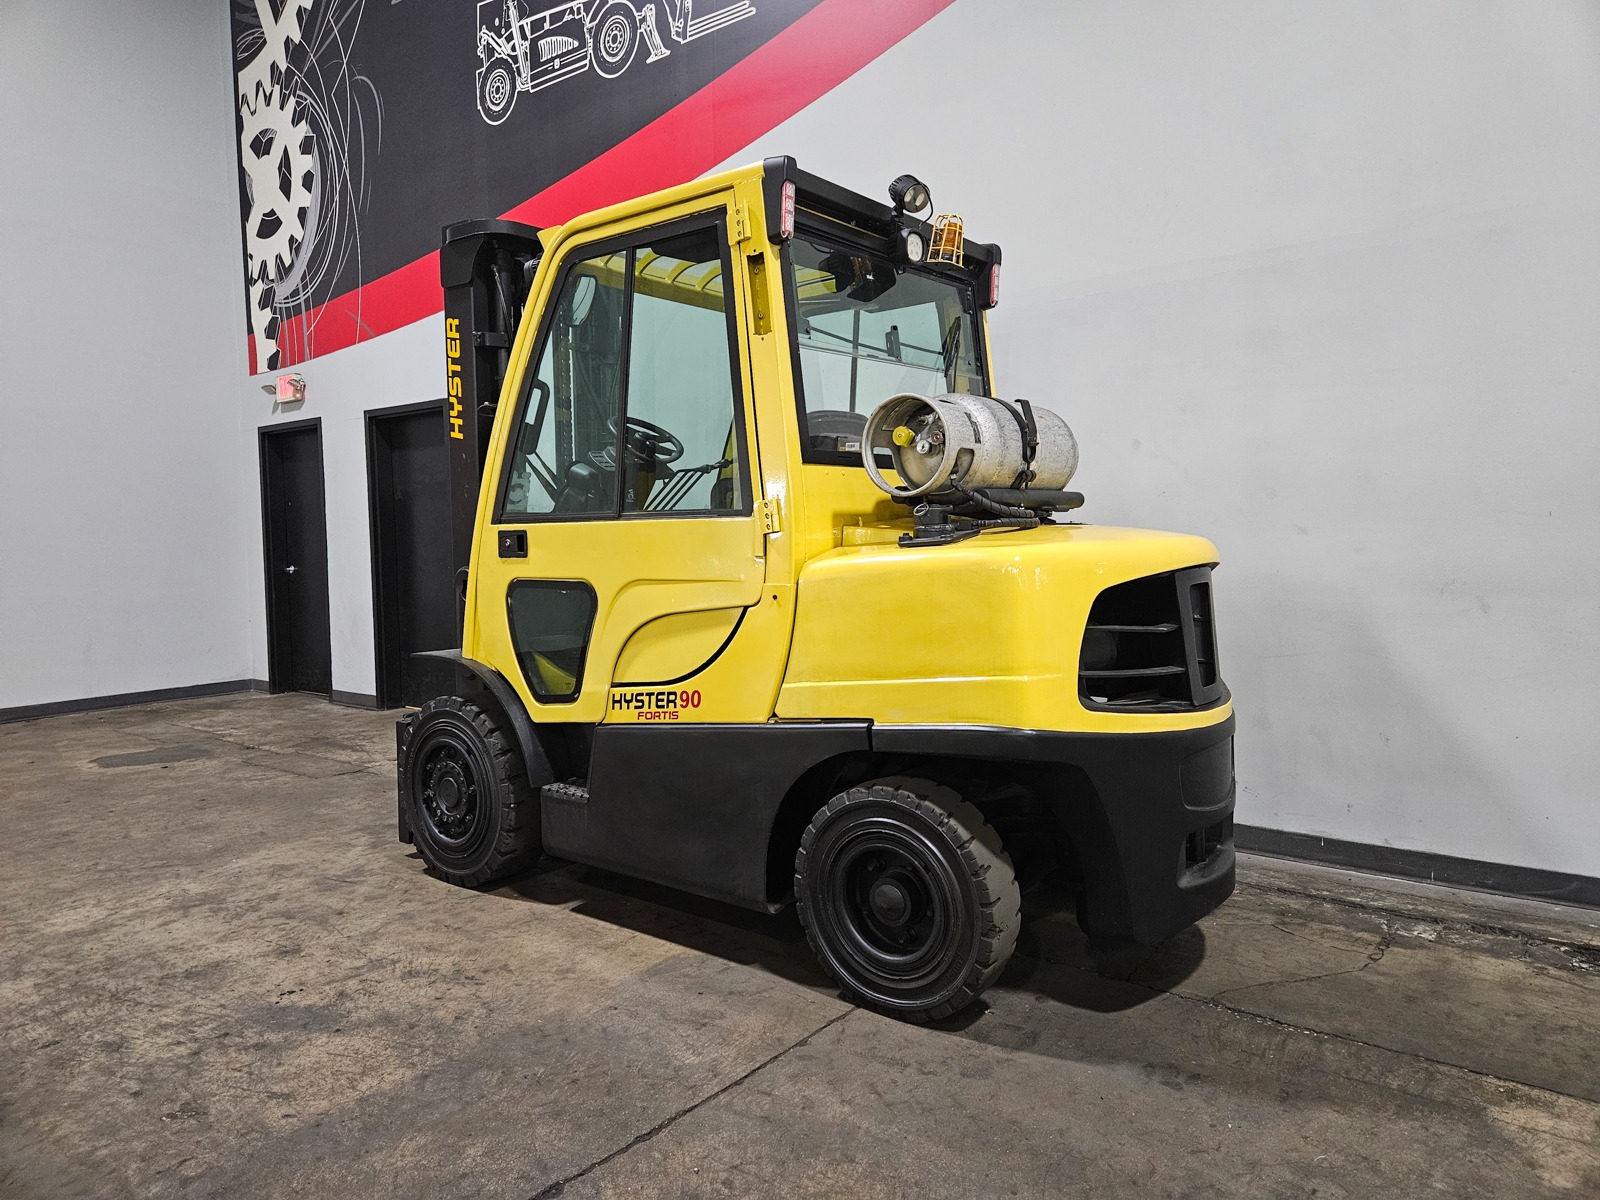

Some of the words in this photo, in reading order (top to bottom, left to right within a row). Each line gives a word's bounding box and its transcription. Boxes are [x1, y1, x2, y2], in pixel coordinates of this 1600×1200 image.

[446, 318, 464, 440] HYSTER
[612, 691, 678, 710] HYSTER
[680, 690, 702, 709] 90
[637, 711, 679, 720] FORTIS
